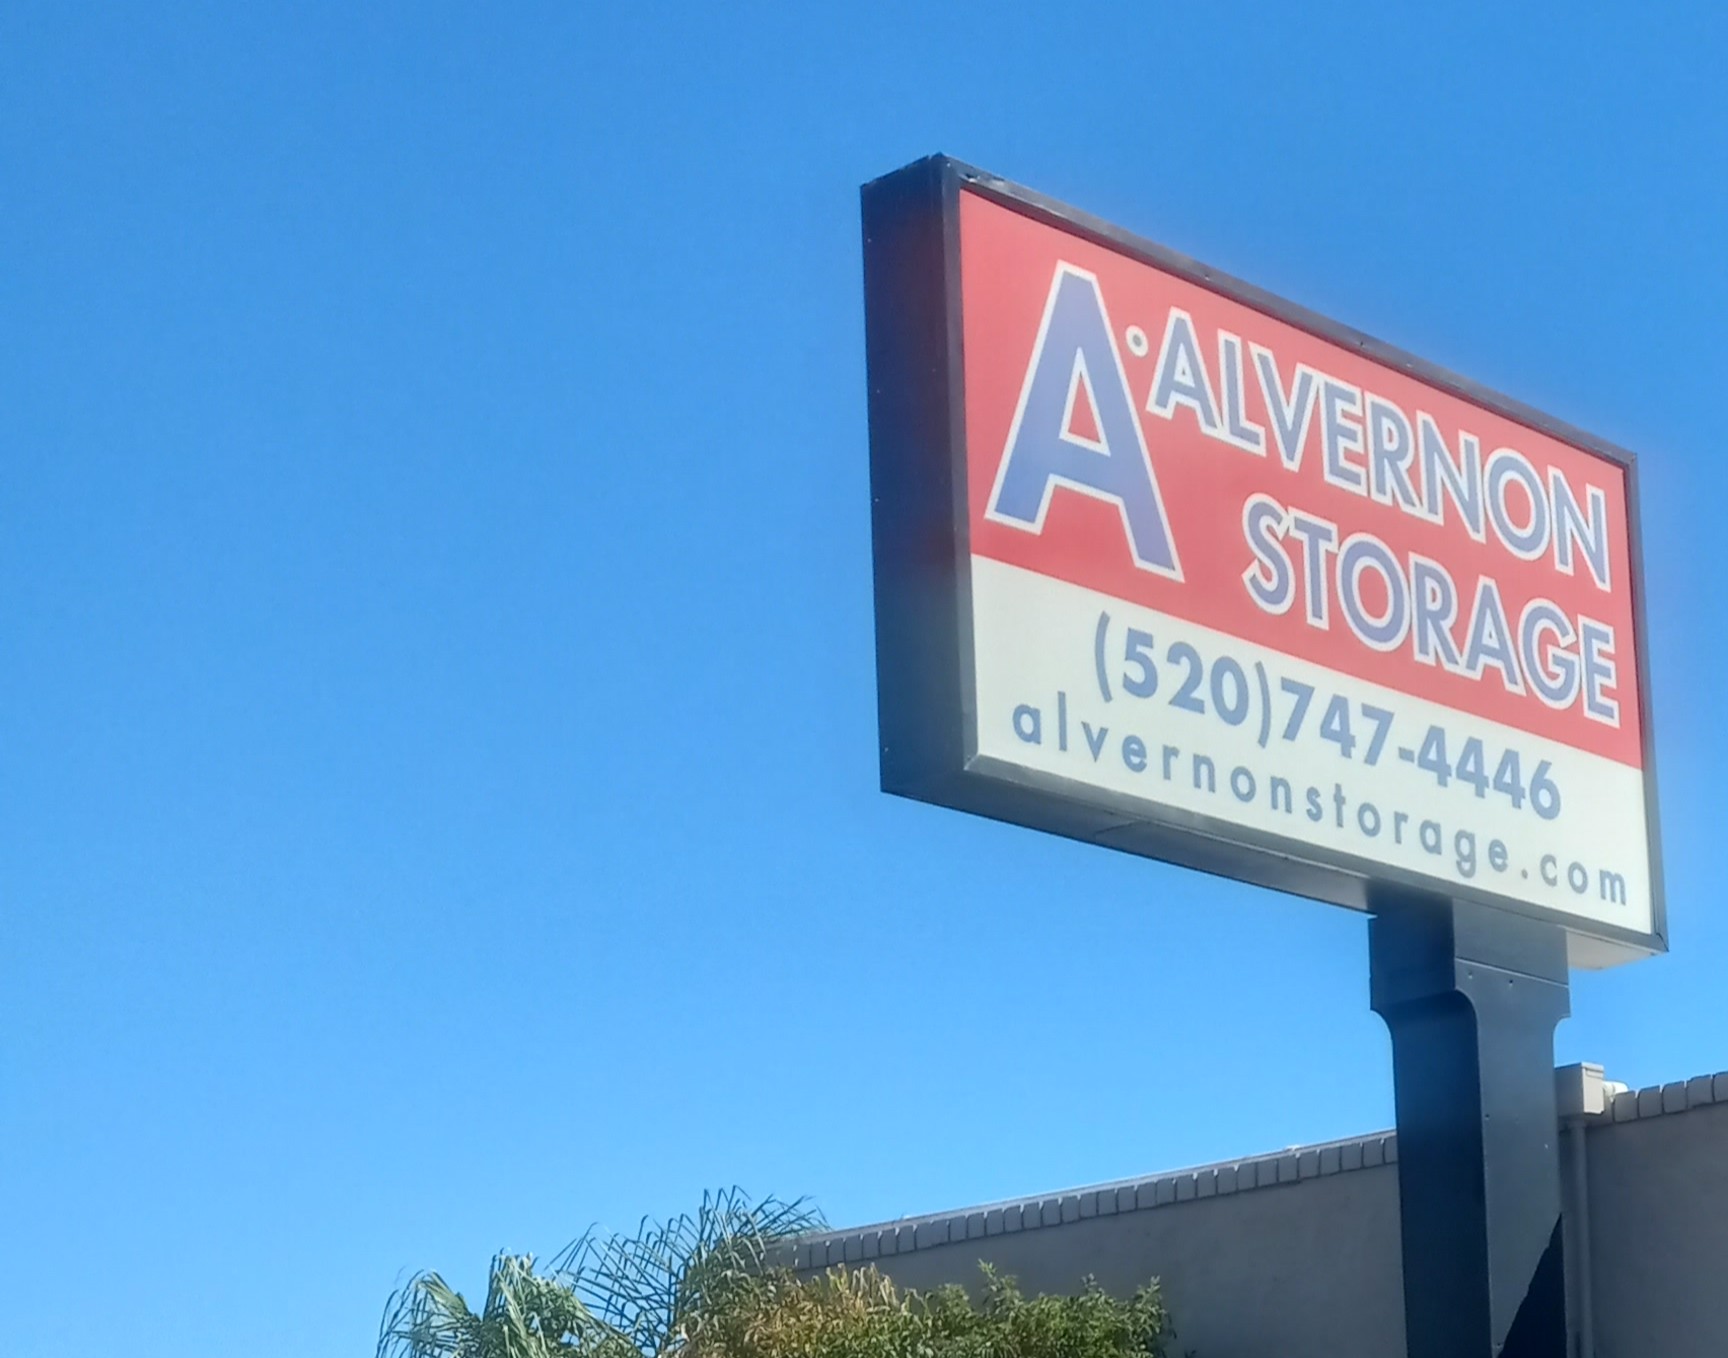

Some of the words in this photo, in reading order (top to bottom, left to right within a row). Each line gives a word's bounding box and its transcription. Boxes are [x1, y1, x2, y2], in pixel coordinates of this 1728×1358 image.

[984, 259, 1185, 583] A
[1145, 306, 1611, 591] ALVERNON
[1095, 610, 1562, 820] (520)747-4446
[1242, 492, 1620, 728] STORAGE
[1012, 690, 1627, 906] alvernonstorage.com
